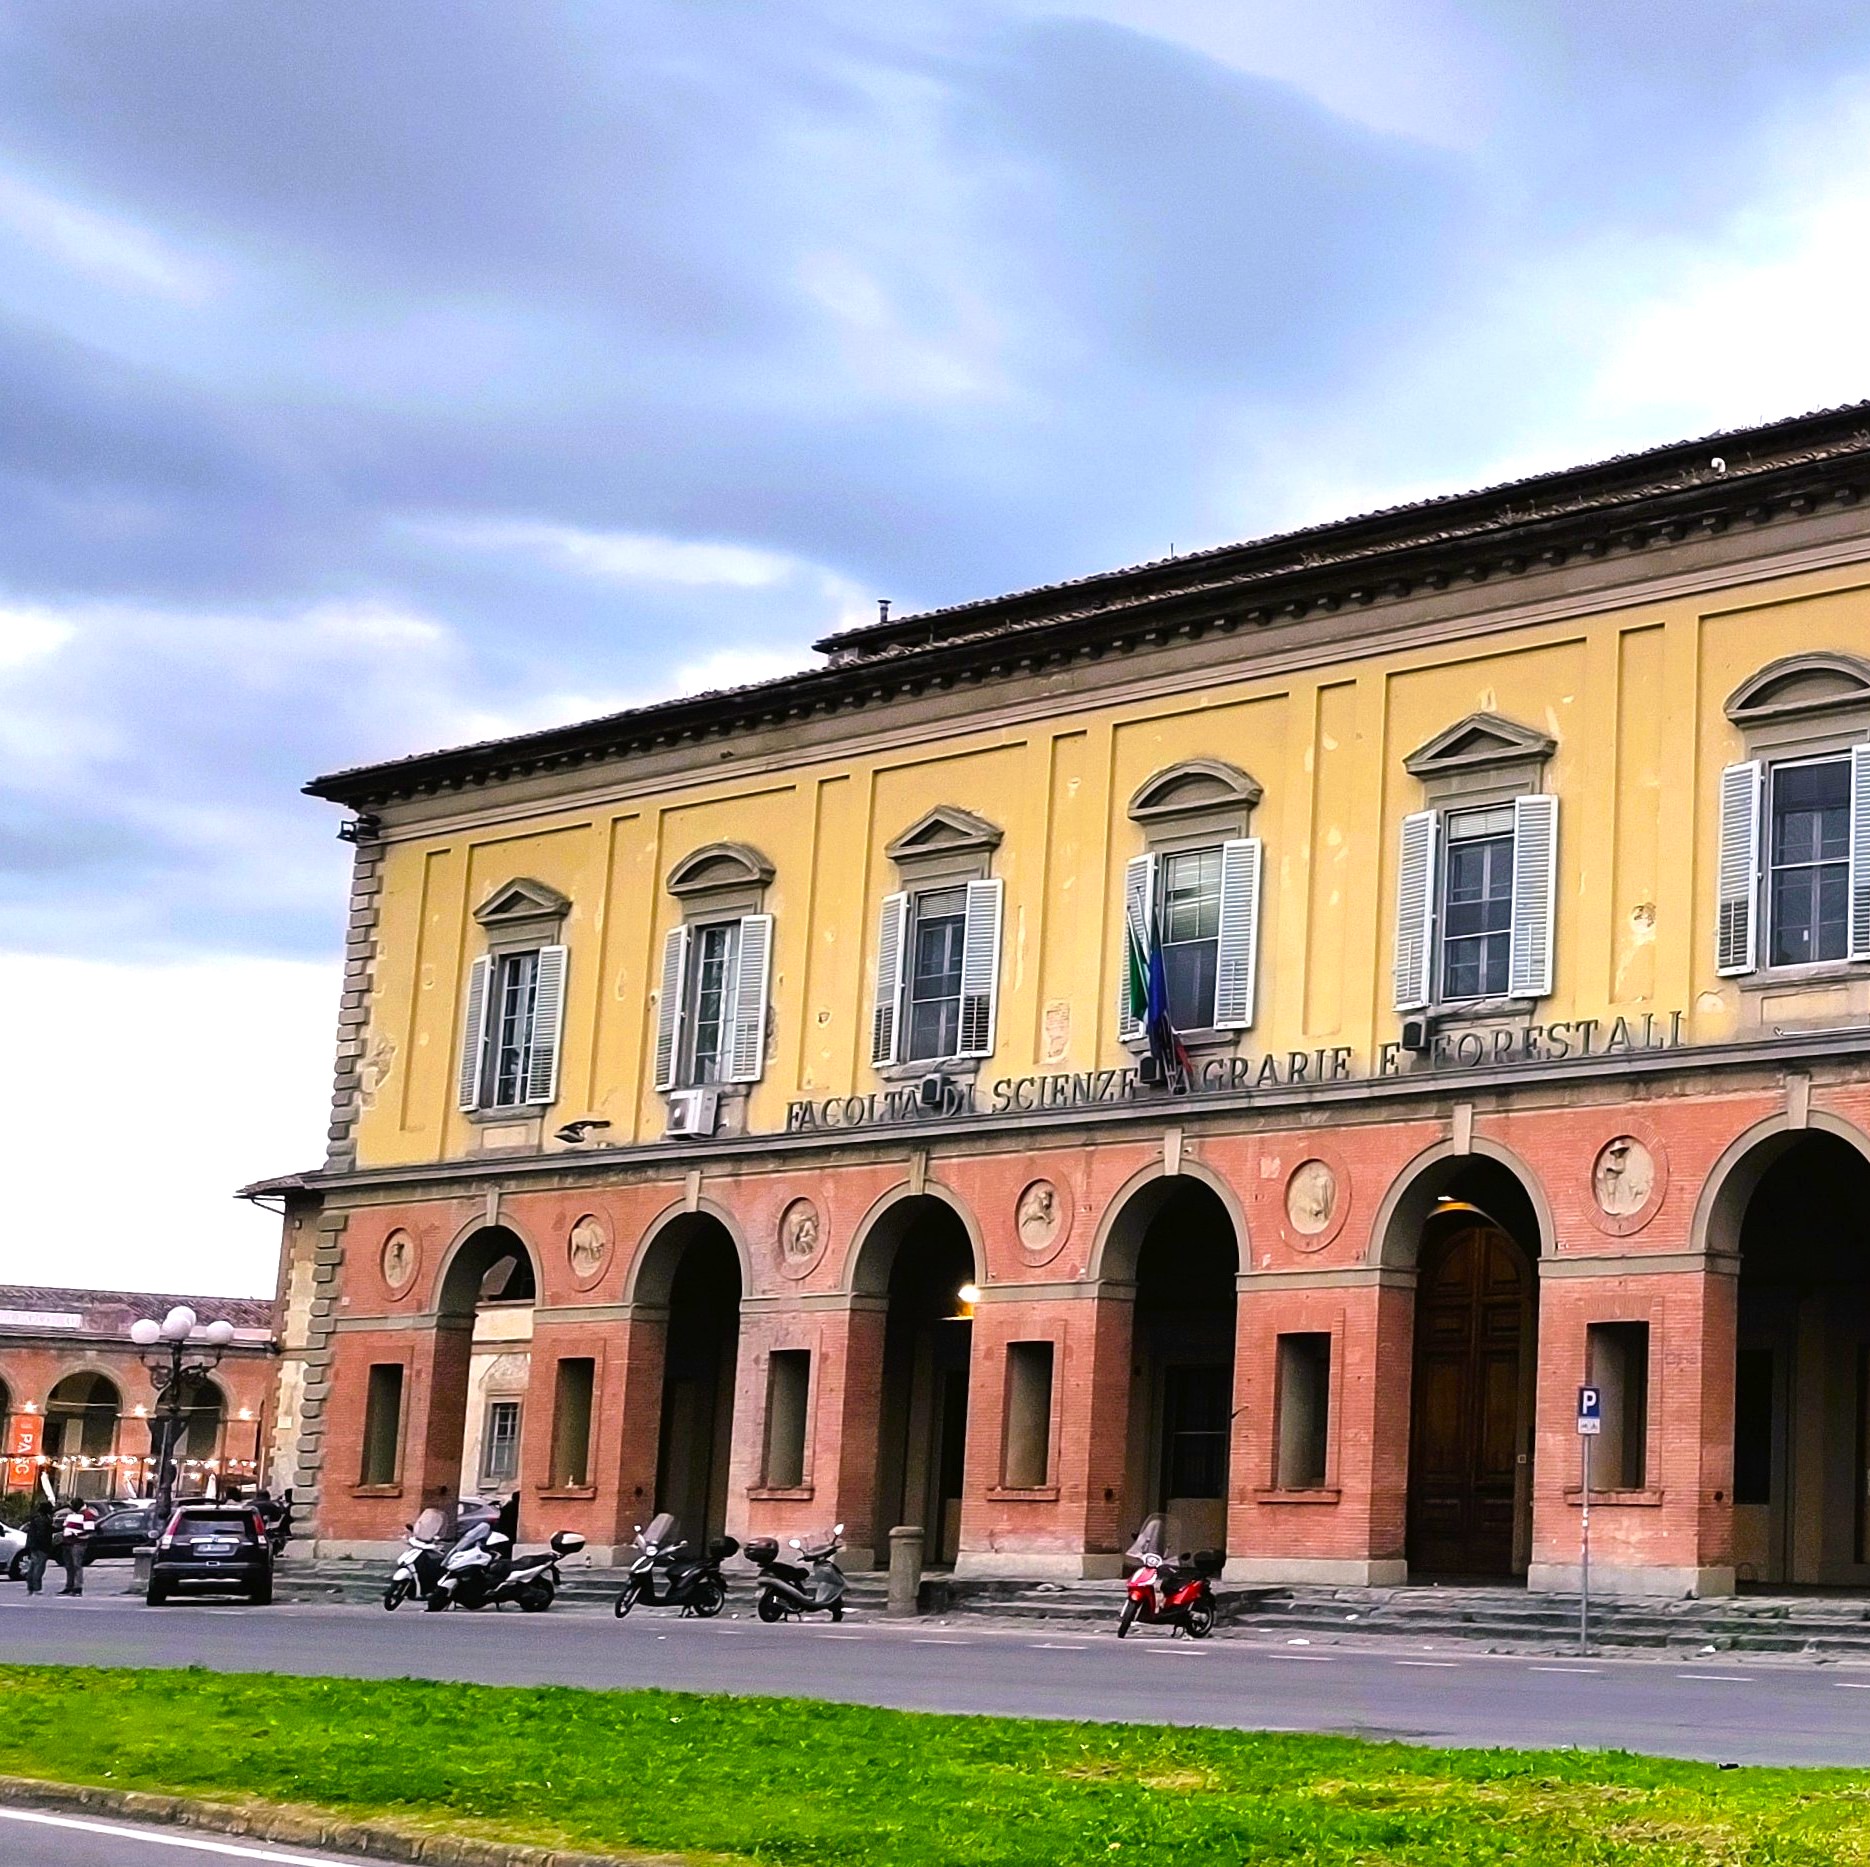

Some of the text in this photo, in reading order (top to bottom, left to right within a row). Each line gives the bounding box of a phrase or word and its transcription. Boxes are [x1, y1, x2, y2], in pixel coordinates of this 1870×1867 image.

[942, 1083, 975, 1117] DI
[991, 1067, 1139, 1113] SCIENZE
[1378, 1041, 1401, 1077] E
[1429, 1010, 1683, 1069] FORESTALI
[1583, 1390, 1597, 1415] P
